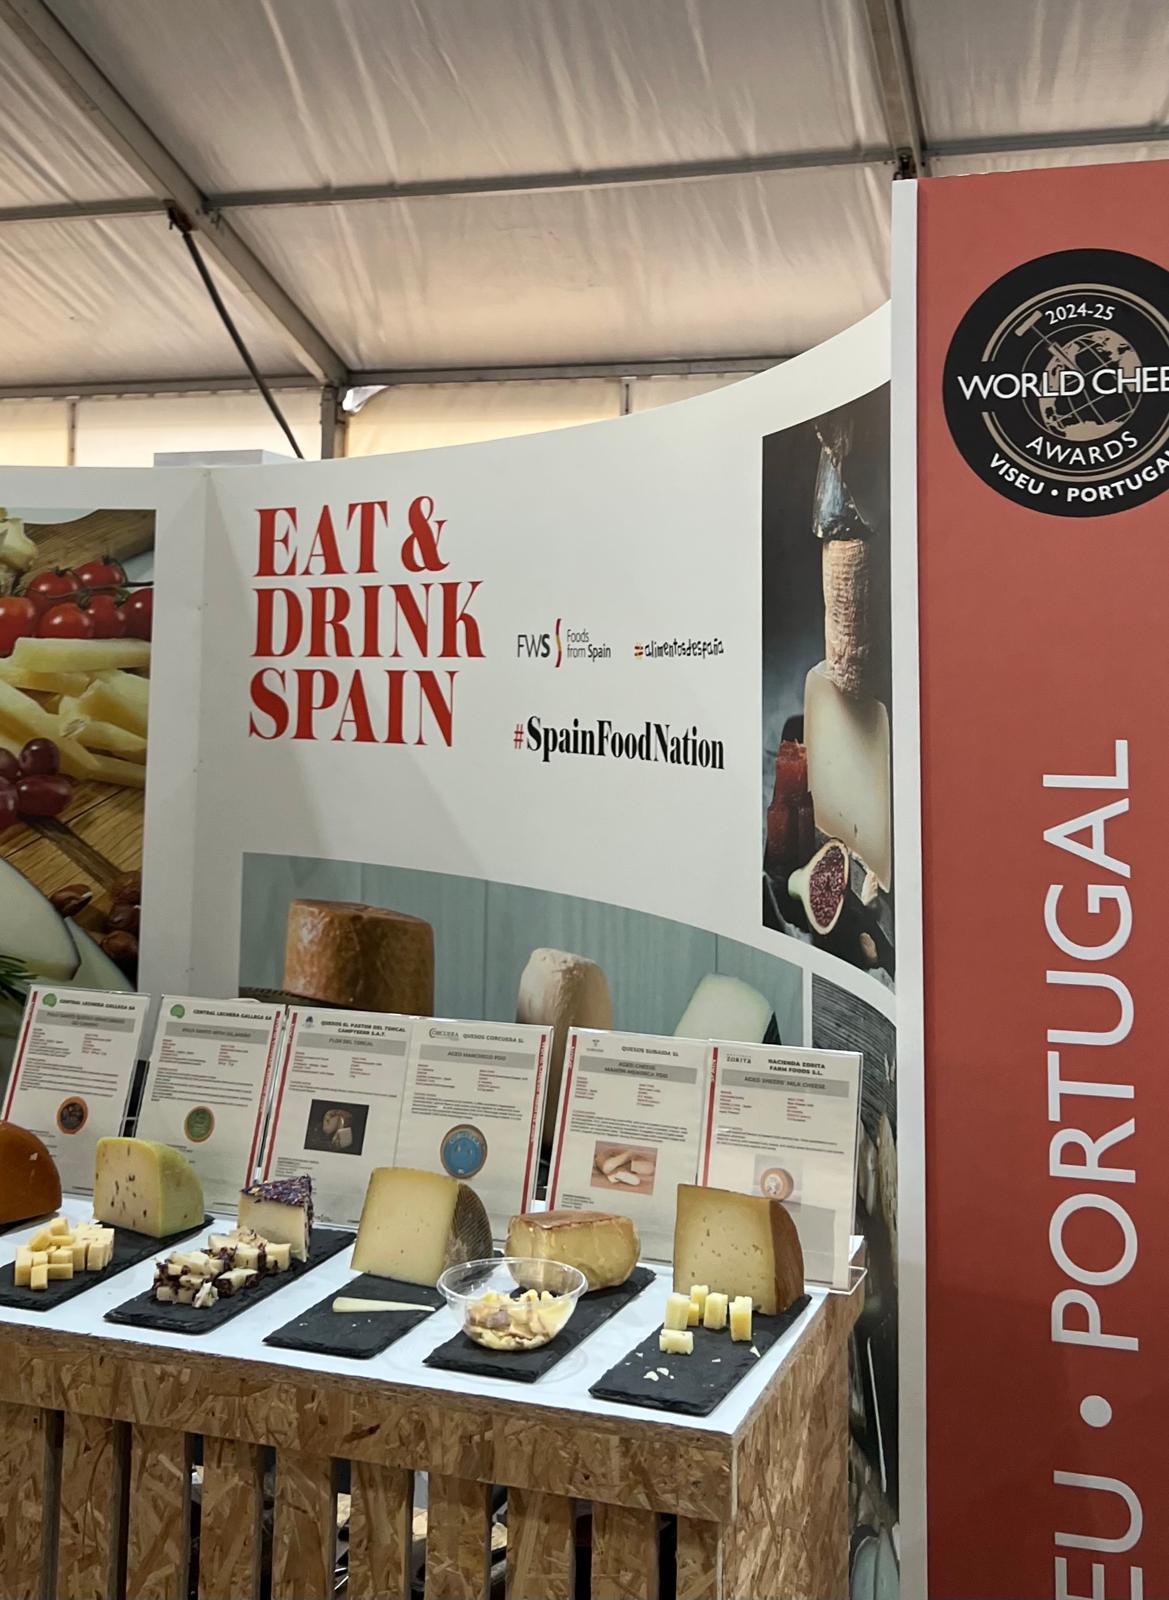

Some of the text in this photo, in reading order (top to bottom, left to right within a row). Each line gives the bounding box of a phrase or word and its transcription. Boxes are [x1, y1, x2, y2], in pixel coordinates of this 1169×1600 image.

[1045, 303, 1115, 325] 2024-25
[957, 370, 1086, 401] WORLD
[1025, 430, 1138, 465] AWARDS
[988, 453, 1045, 495] VISEU
[252, 496, 450, 578] EAT &
[250, 580, 487, 659] DRINK
[517, 634, 550, 658] FWS
[567, 628, 589, 643] Foods
[567, 643, 612, 662] from Spain
[249, 666, 460, 748] SPAIN
[513, 715, 725, 770] #SpainFoodNation
[621, 1046, 644, 1054] QUESOS
[1043, 740, 1139, 1351] PORTUGAL
[768, 1058, 800, 1067] HACIENDA
[788, 1067, 810, 1075] FOODS
